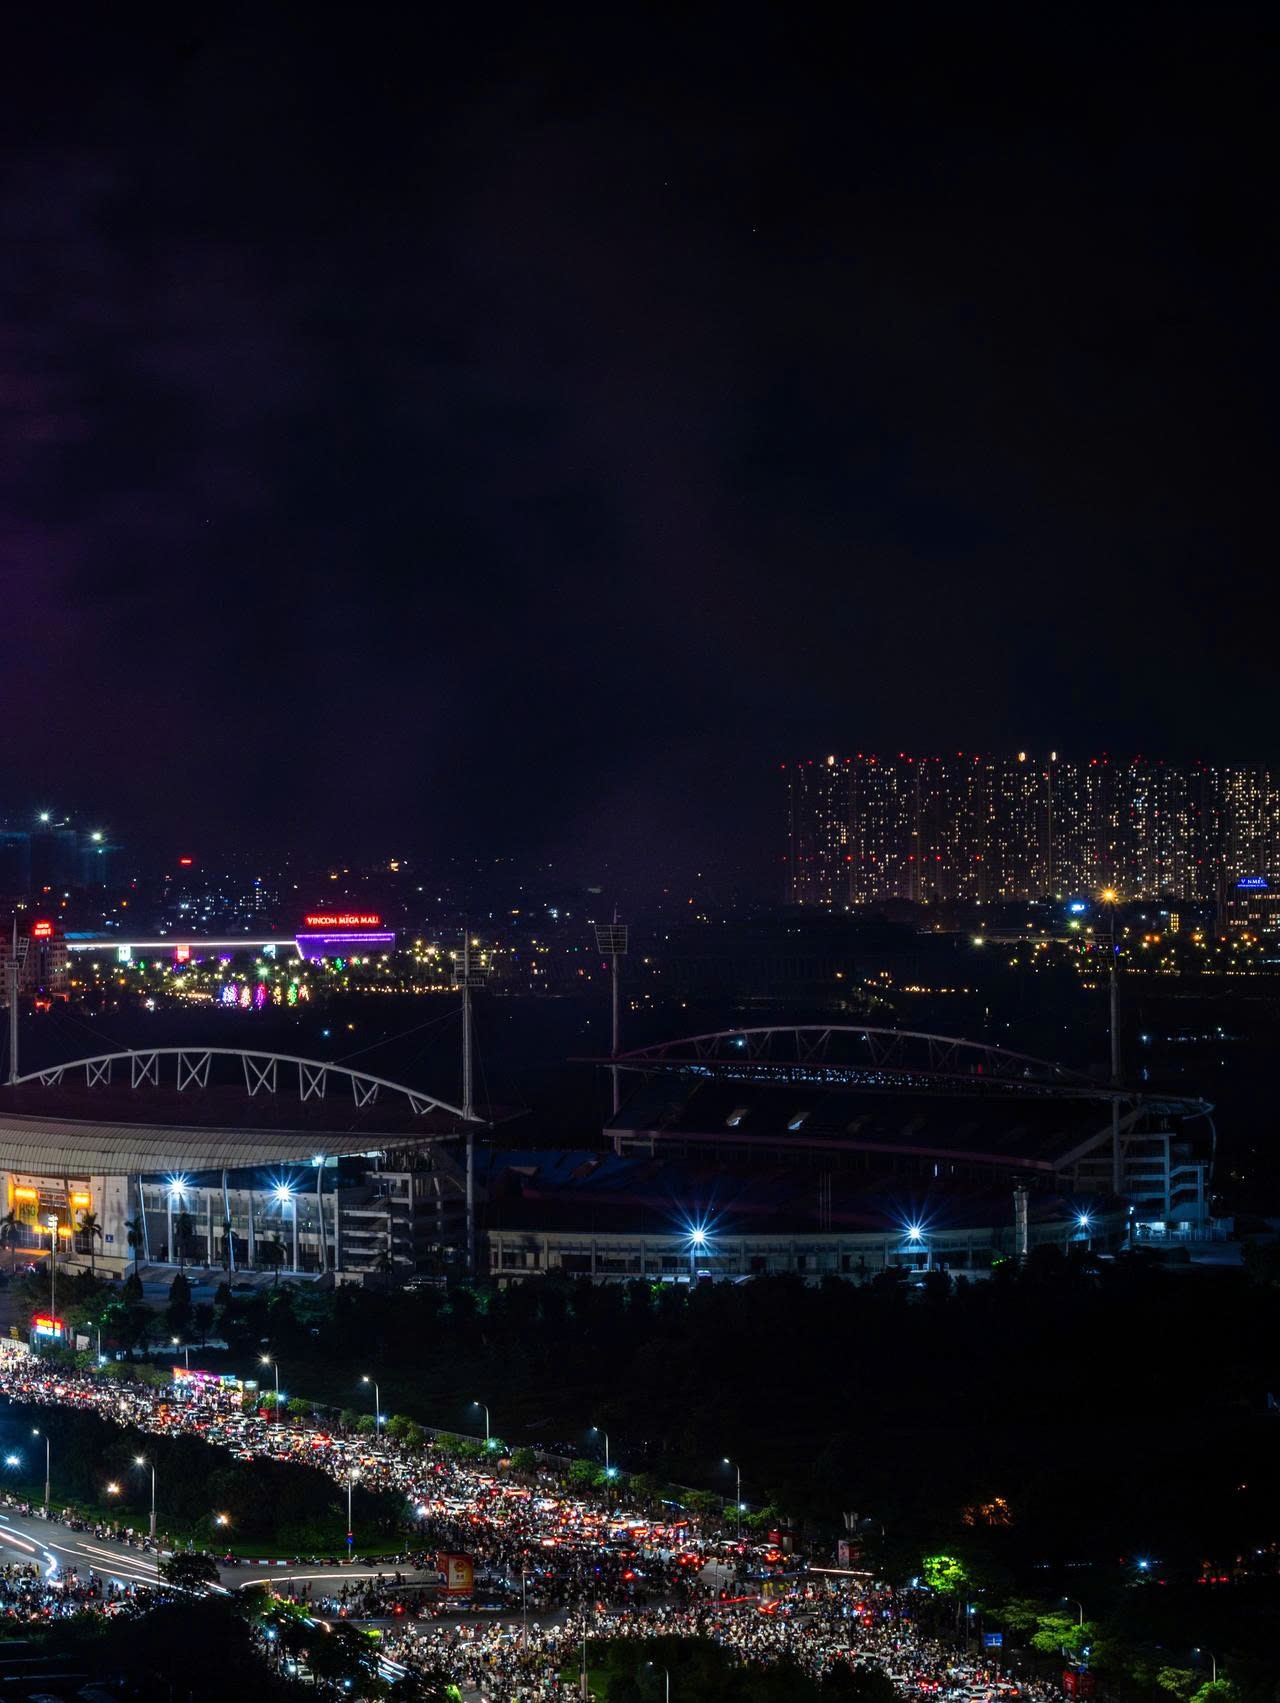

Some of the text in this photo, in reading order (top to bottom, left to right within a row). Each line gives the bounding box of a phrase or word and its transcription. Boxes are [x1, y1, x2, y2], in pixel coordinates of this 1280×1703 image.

[307, 916, 379, 925] VINCOM MEGA MALL
